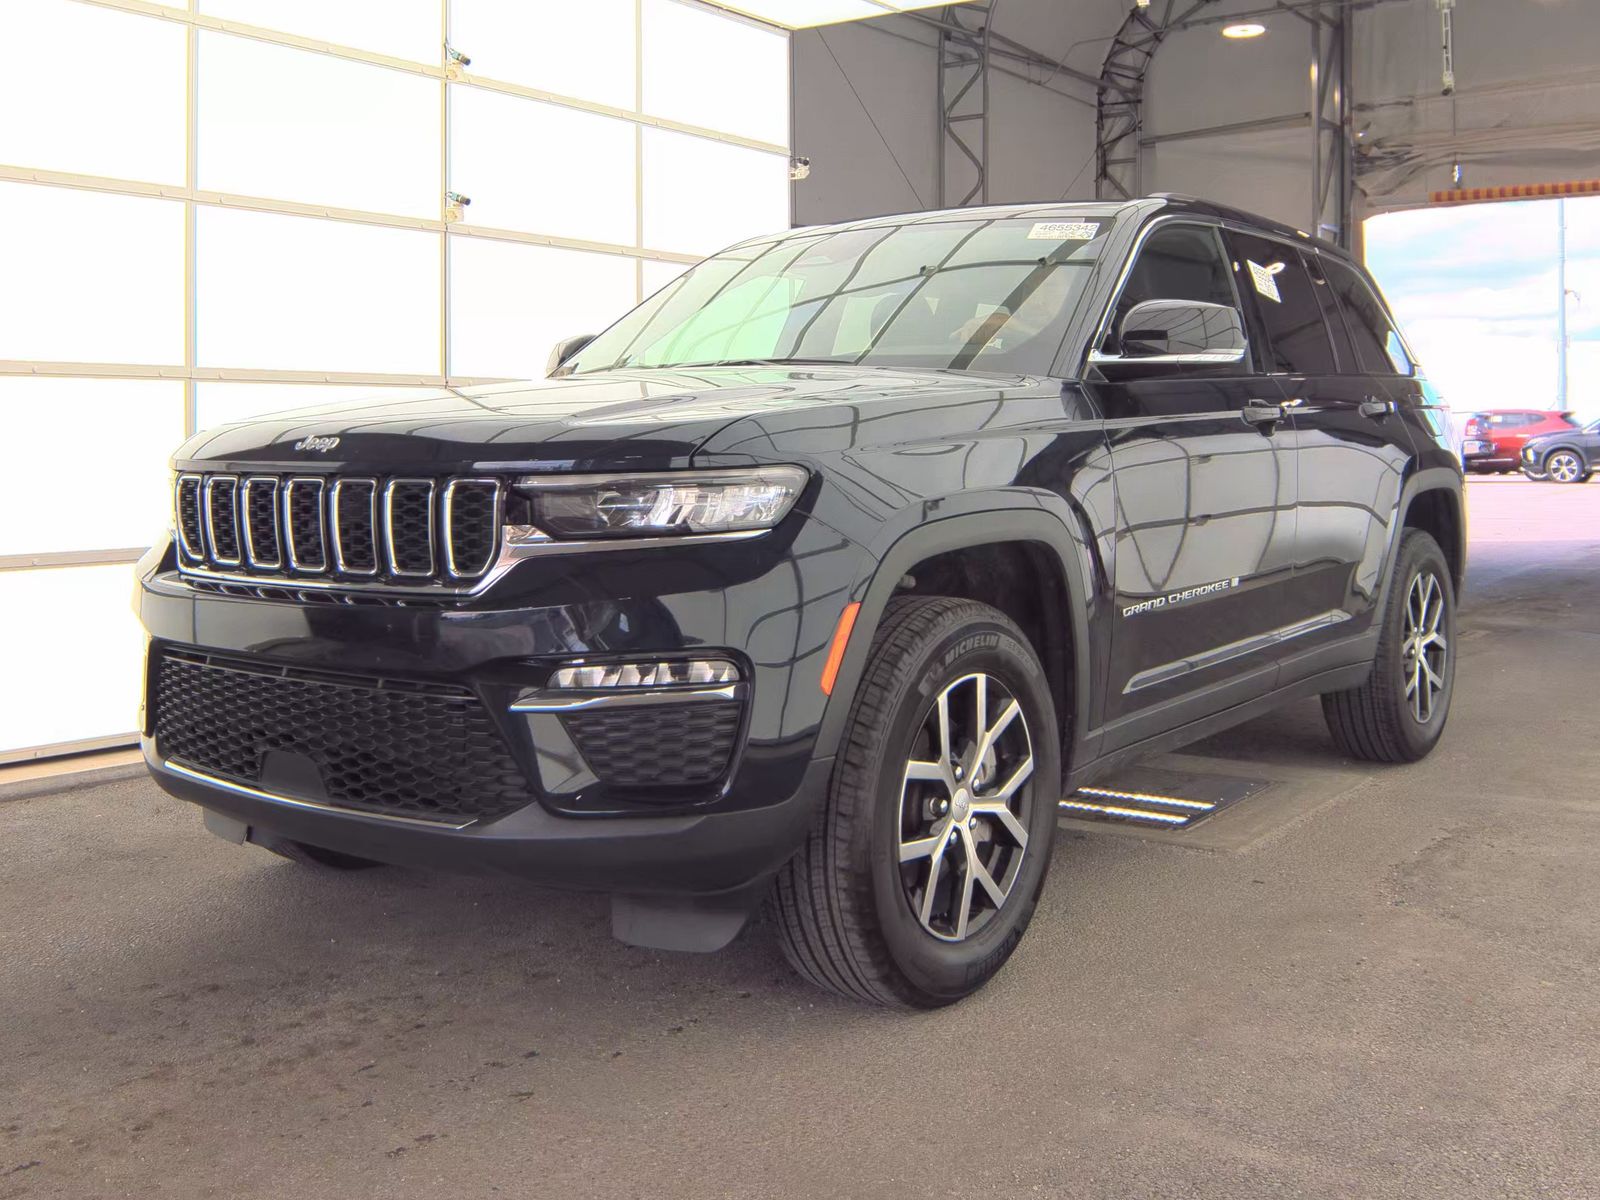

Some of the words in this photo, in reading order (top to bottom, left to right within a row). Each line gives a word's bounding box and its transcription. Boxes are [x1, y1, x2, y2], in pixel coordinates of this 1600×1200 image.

[1039, 223, 1098, 232] 4655342
[294, 434, 340, 453] Jeep
[1122, 597, 1166, 617] GRAND
[1167, 579, 1230, 604] CHEROKEE
[944, 634, 999, 667] MICHELIN
